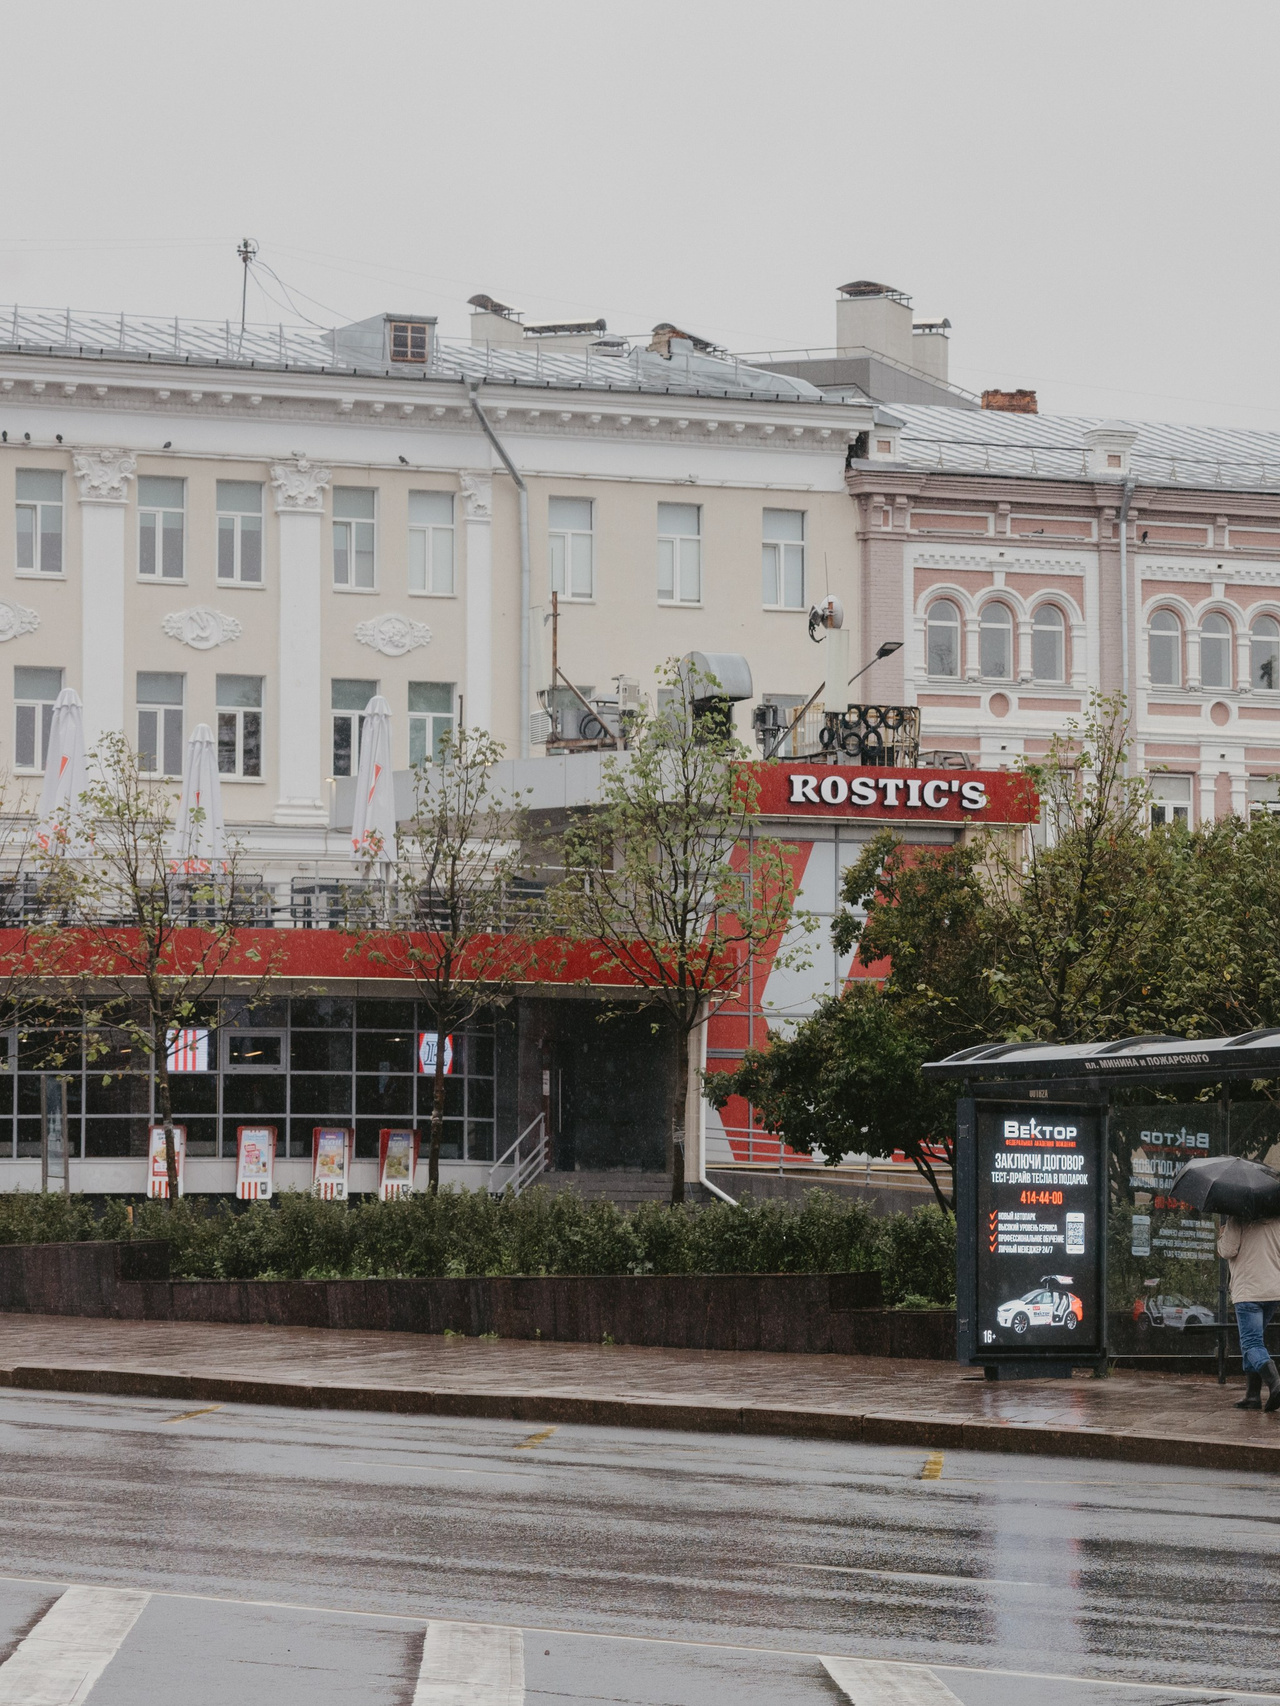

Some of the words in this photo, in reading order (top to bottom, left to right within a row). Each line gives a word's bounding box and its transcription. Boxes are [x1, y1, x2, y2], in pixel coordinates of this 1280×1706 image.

[789, 774, 988, 810] ROSTIC'S
[1085, 1061, 1099, 1070] пл.
[1099, 1056, 1140, 1069] МИНИНА
[1139, 1058, 1147, 1067] и
[1147, 1053, 1210, 1067] ПОЖАРСКОГО
[1004, 1117, 1077, 1139] ВЕКТОР
[994, 1152, 1041, 1170] ЗАКЛЮЧИ
[1042, 1154, 1085, 1172] ДОГОВОР
[991, 1170, 1031, 1184] ТЕСТ-ДРАЙВ
[1031, 1172, 1053, 1184] ТЕСЛА
[1053, 1173, 1059, 1184] В
[1058, 1173, 1089, 1186] ПОДАРОК
[1020, 1190, 1063, 1205] 414-44-00
[998, 1211, 1014, 1220] НОВЫЙ
[1014, 1212, 1037, 1221] АВТОПАРК
[1019, 1224, 1038, 1232] УРОВЕНЬ
[1039, 1224, 1058, 1232] СЕРВИСА
[998, 1234, 1042, 1243] ПРОФЕССИОНАЛЬНОЕ
[1043, 1235, 1065, 1243] ОБУЧЕНИЕ
[1042, 1245, 1054, 1254] 24/7
[983, 1330, 997, 1344] 16+
